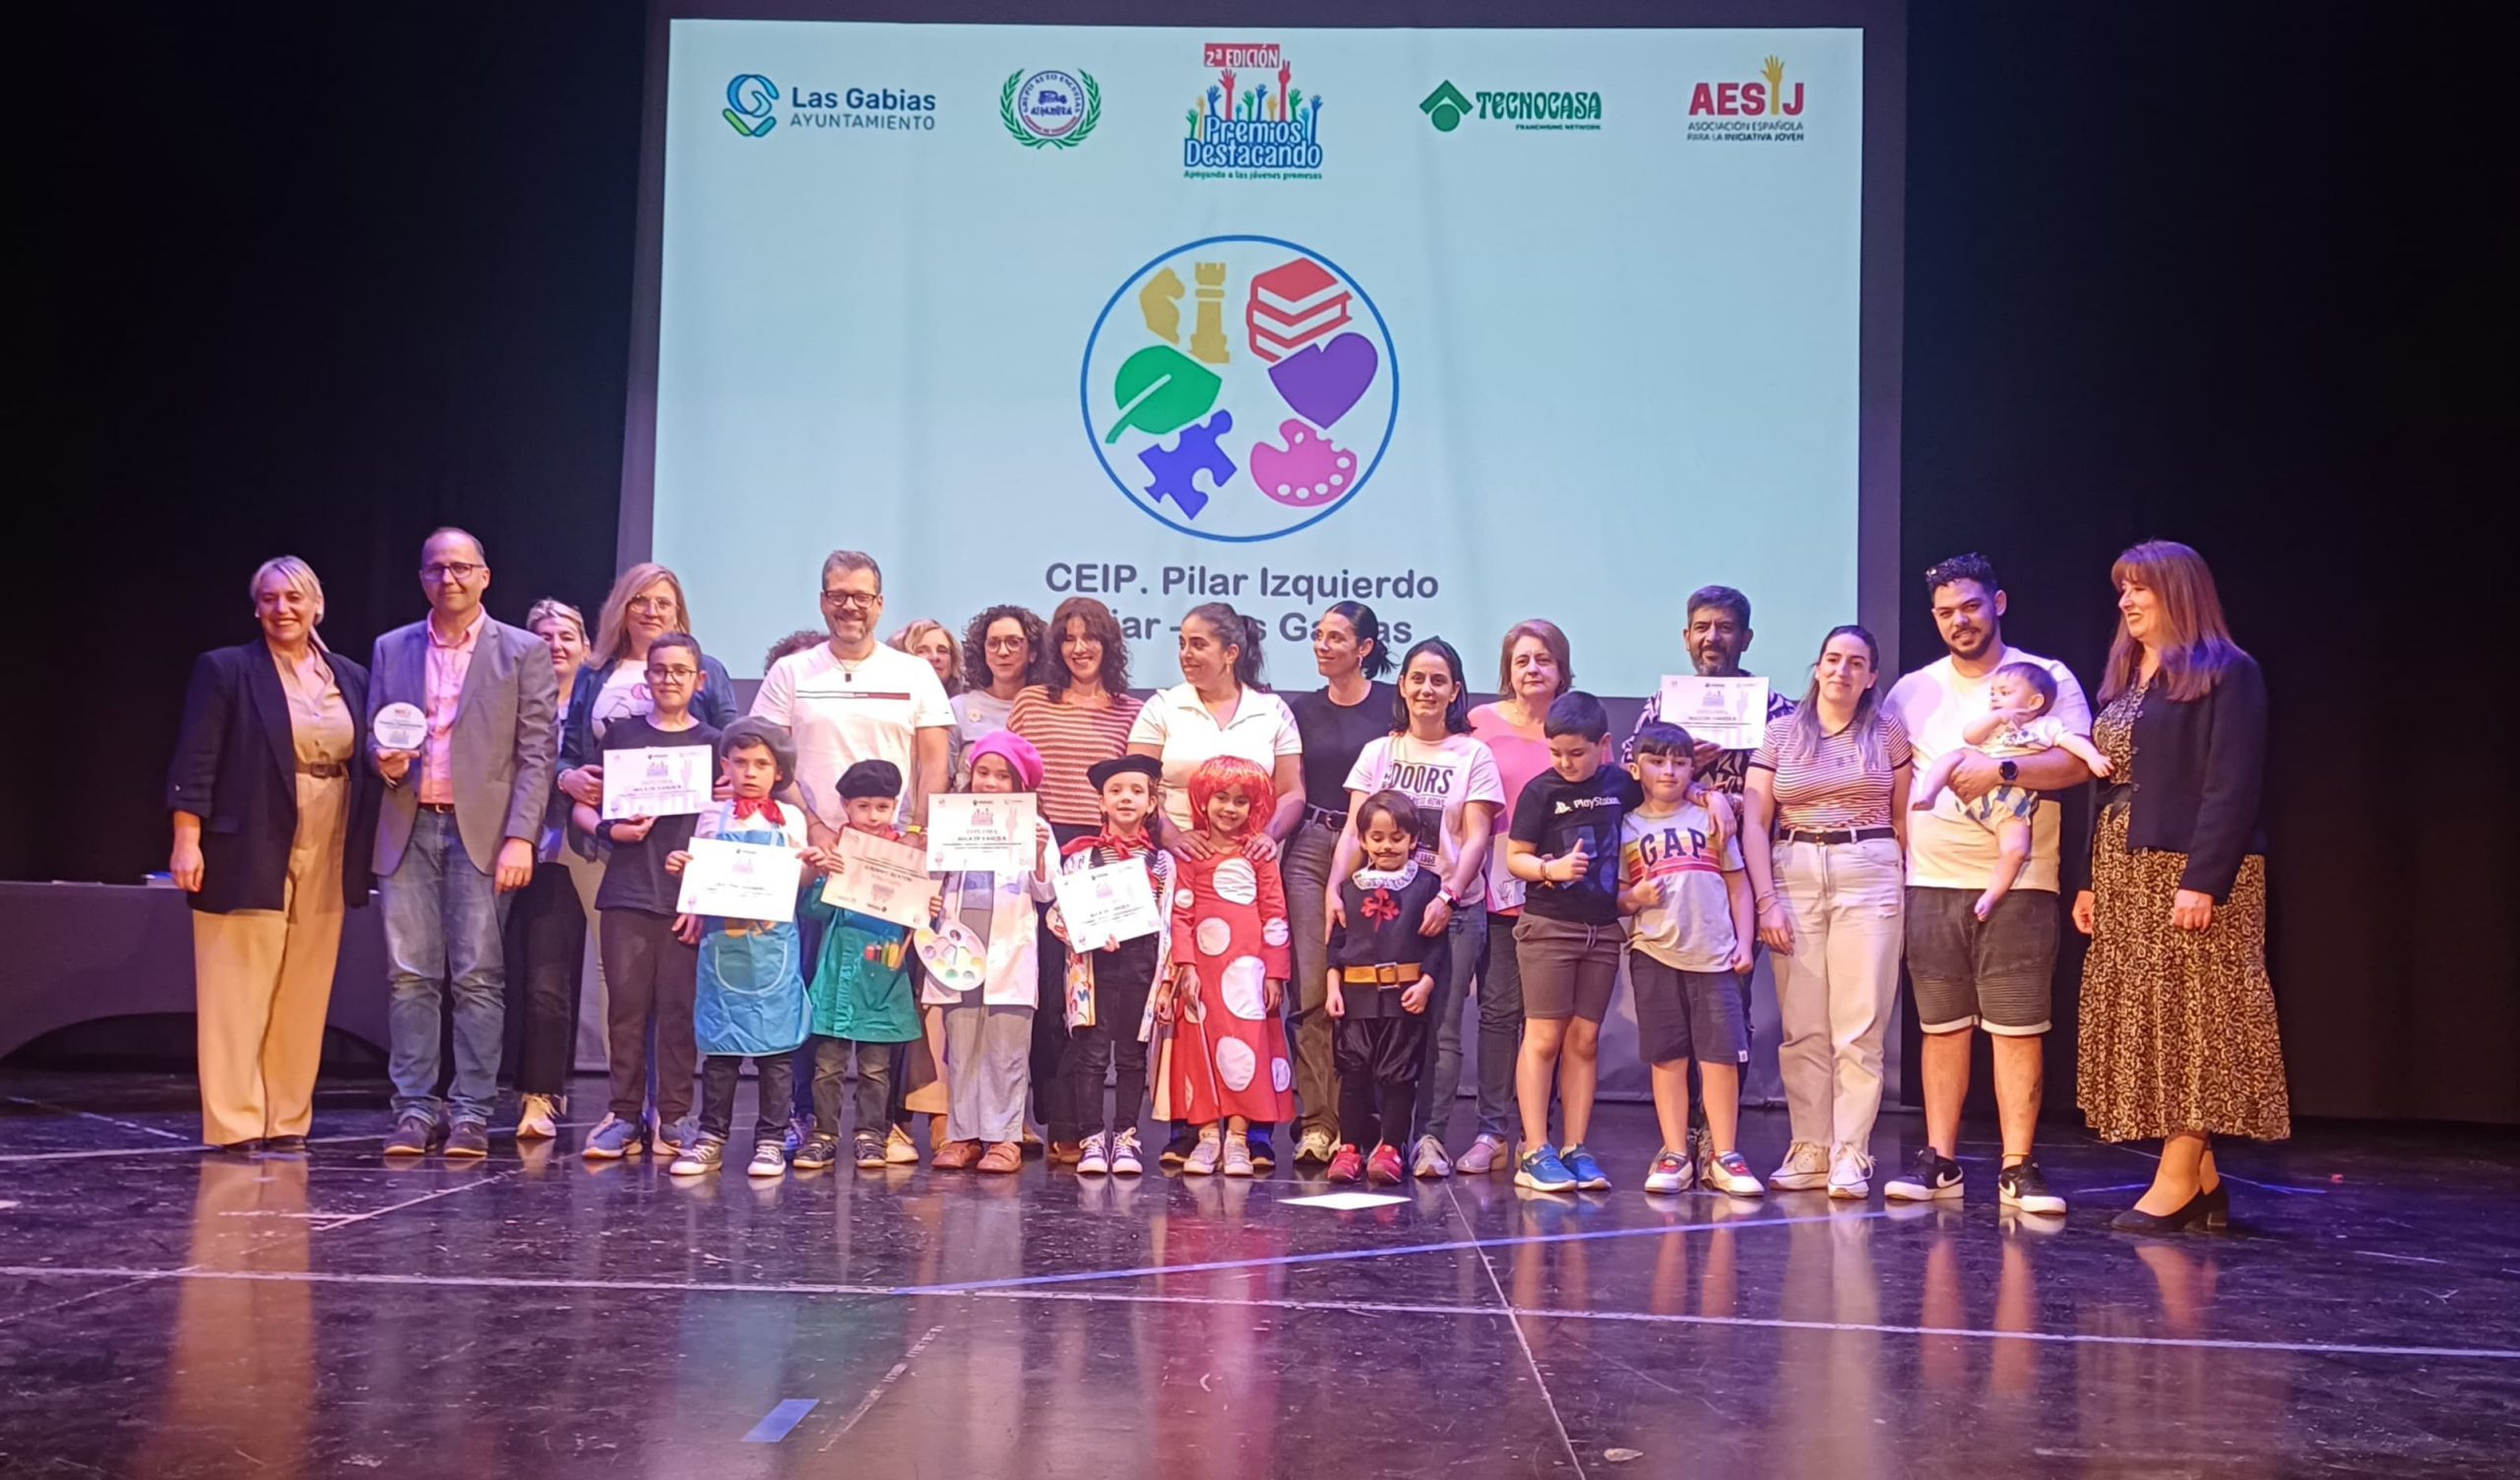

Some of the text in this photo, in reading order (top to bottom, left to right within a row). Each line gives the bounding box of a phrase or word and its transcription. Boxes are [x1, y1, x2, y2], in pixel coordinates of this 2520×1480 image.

[1226, 44, 1279, 68] EDICIÓN
[792, 87, 936, 111] Las Gabias
[1477, 92, 1602, 120] TECNOCASA
[790, 113, 935, 130] AYUNTAMIENTO
[1204, 115, 1302, 147] Premios
[1687, 119, 1803, 132] ASOCIACIÓN ESPAÑOLA
[1713, 133, 1723, 142] LA
[1725, 133, 1772, 142] INICIATIVA
[1774, 133, 1804, 142] JOVEN
[1184, 138, 1323, 168] Destacando
[1045, 562, 1439, 605] CEIP. Pilar Izquierdo
[1389, 762, 1454, 795] DOORS
[1573, 796, 1622, 810] PlayStation
[1639, 828, 1706, 868] GAP
